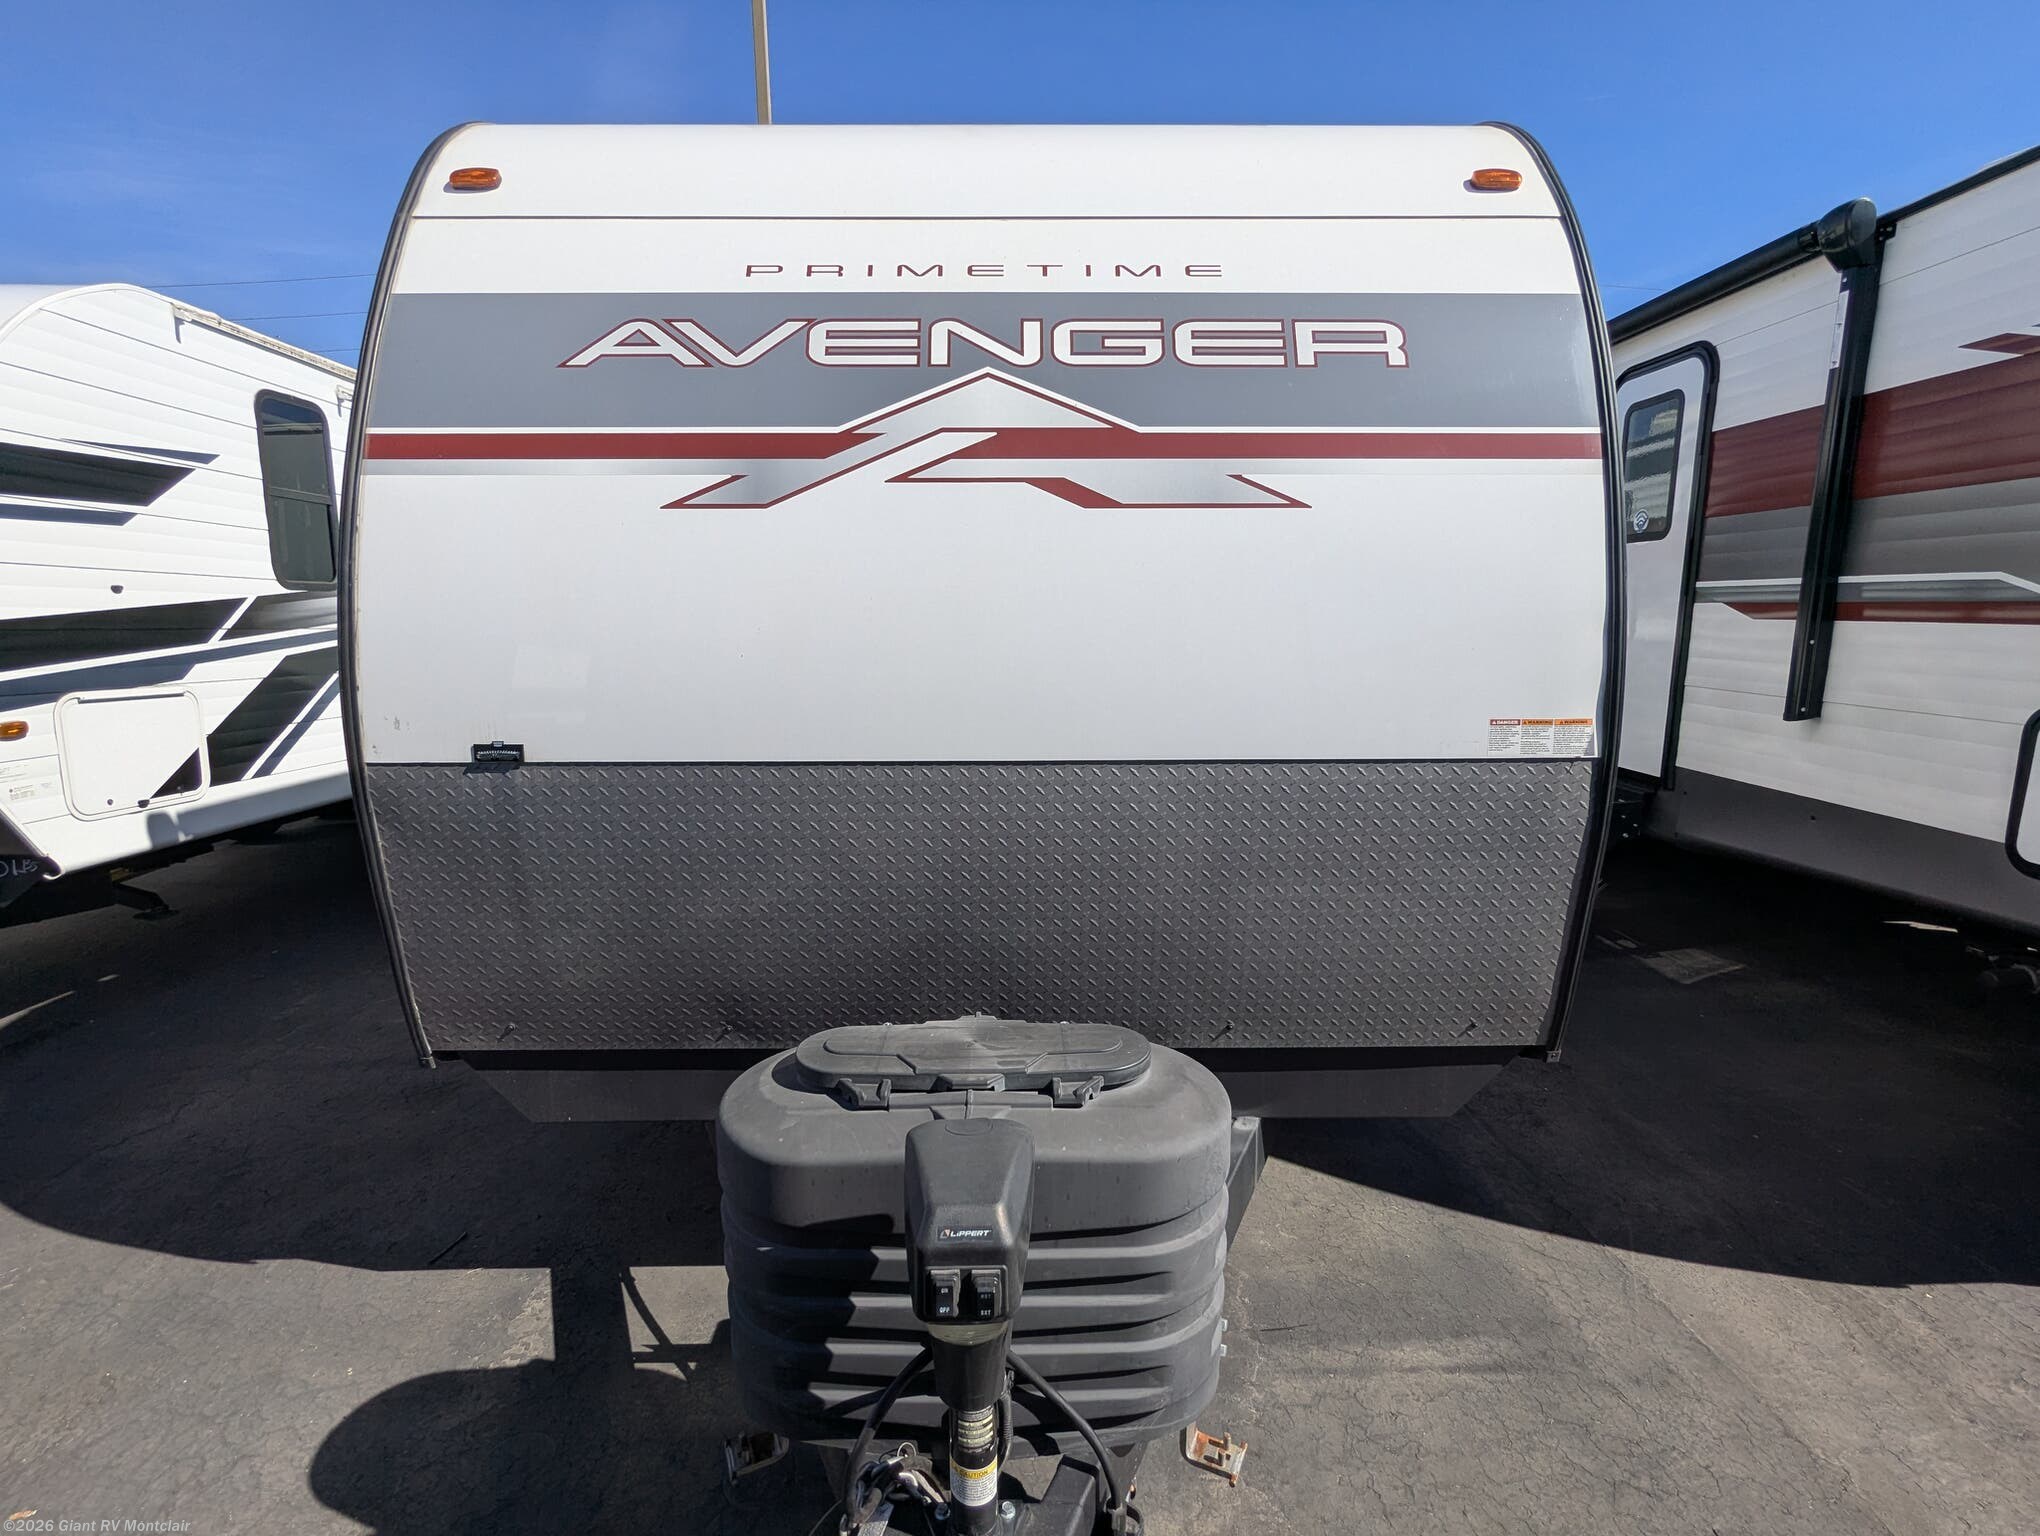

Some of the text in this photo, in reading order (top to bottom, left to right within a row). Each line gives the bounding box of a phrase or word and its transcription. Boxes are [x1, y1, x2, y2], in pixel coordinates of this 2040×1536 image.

[745, 264, 1222, 277] PRIMETIME
[555, 318, 1410, 368] AVENGER
[960, 1469, 988, 1479] CAUTION
